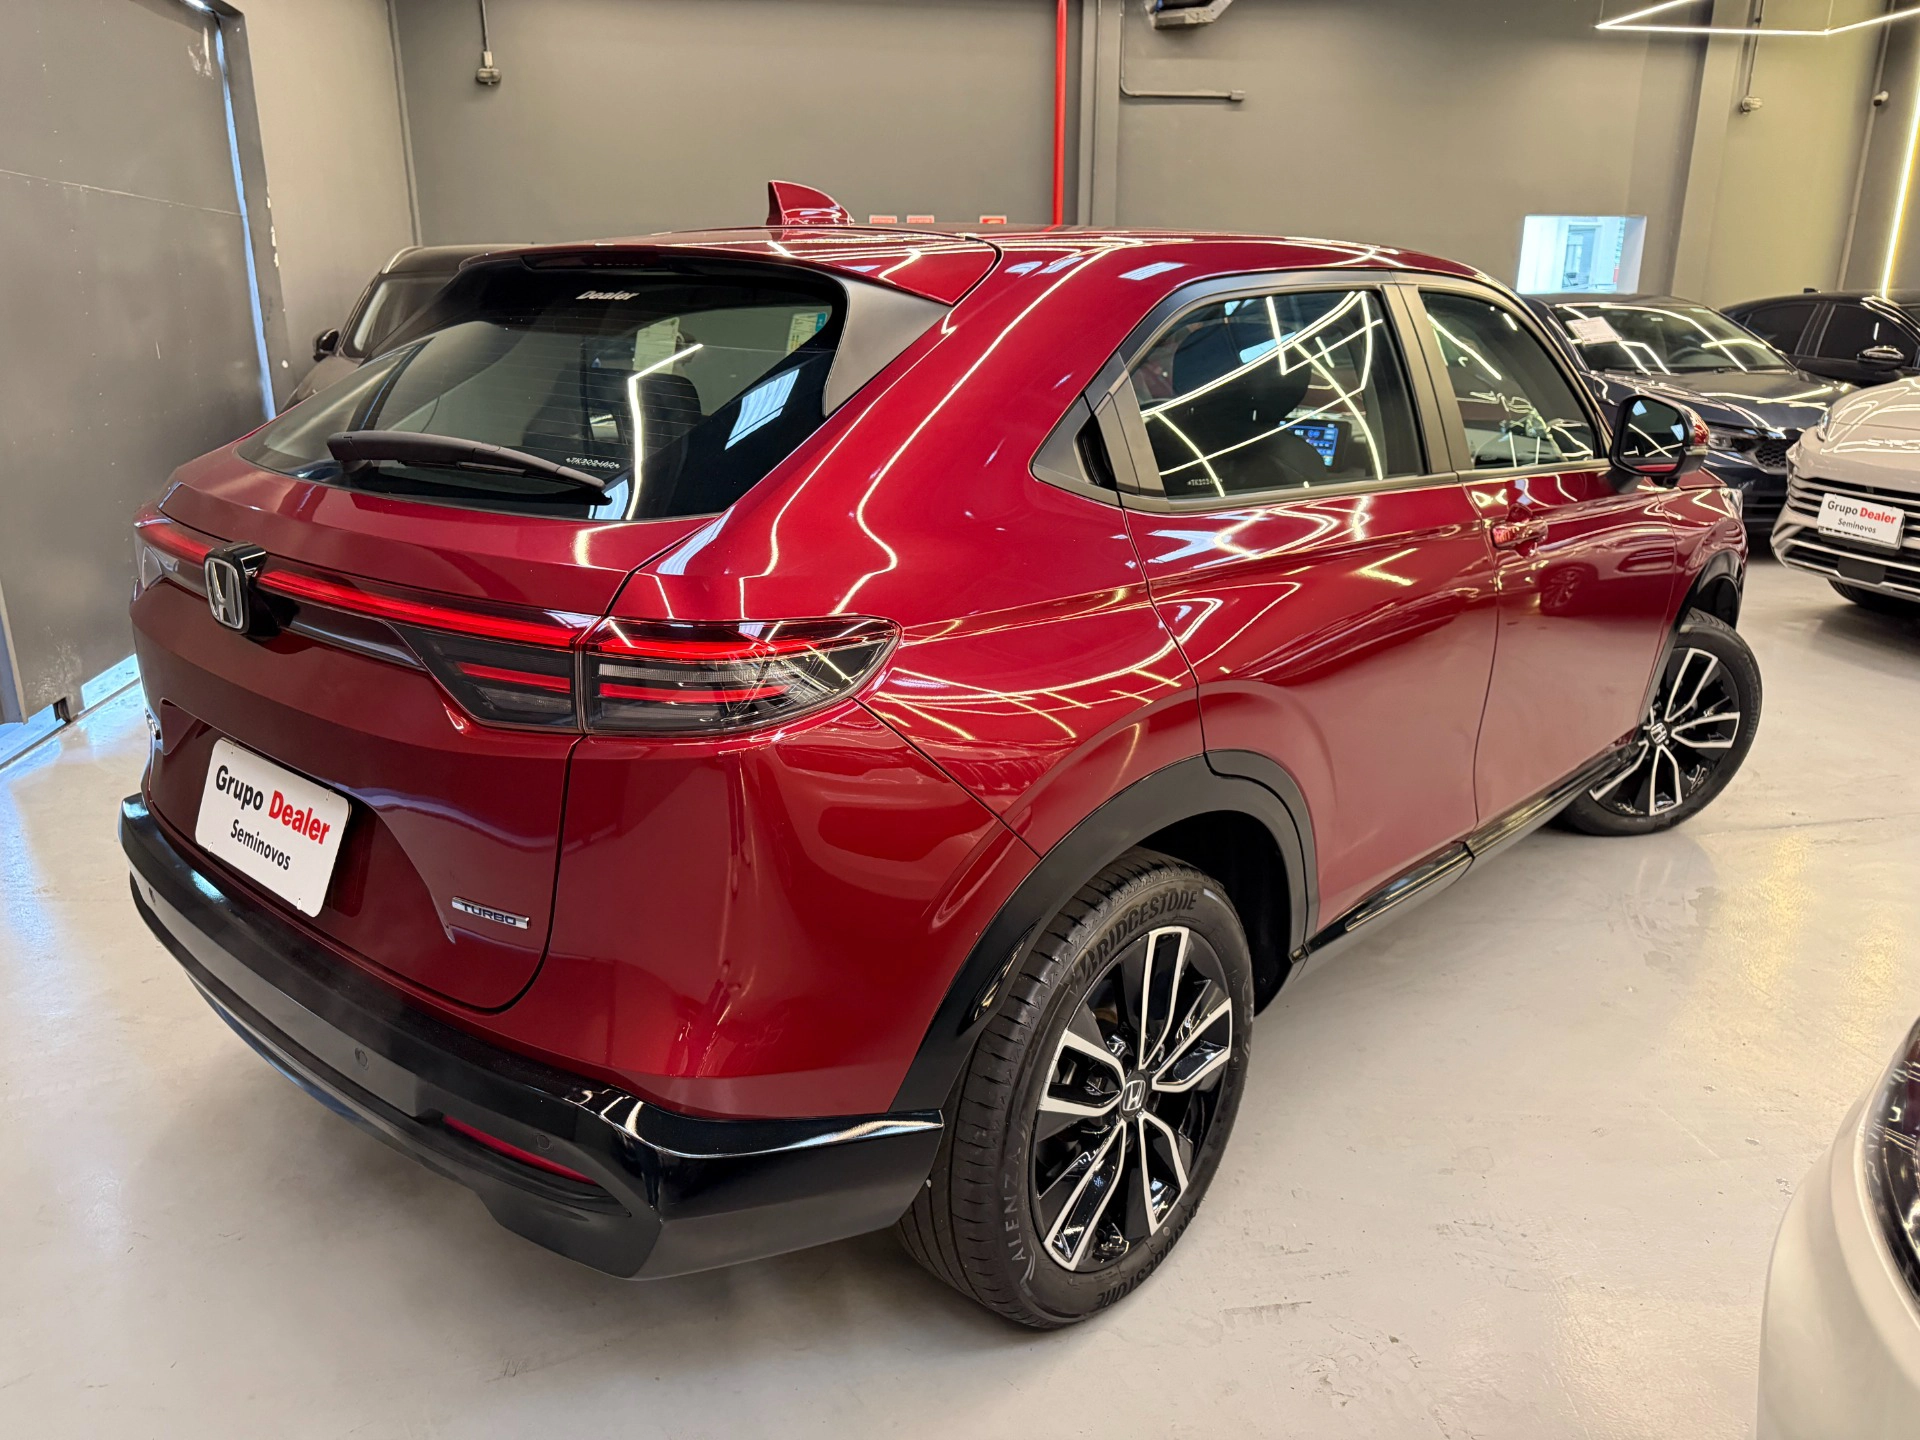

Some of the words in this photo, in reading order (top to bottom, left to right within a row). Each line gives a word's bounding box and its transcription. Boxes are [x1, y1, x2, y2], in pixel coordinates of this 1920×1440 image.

[575, 290, 640, 300] Dealer
[1827, 500, 1858, 516] Grupo
[1859, 507, 1897, 524] Dealer
[1837, 517, 1877, 534] Seminovos
[216, 765, 264, 811] Grupo
[268, 789, 331, 845] Dealer
[230, 819, 291, 871] Seminovos
[461, 902, 517, 926] TURBO
[1078, 887, 1198, 984] BRIDGESTONE
[1003, 1147, 1027, 1261] ALENZA
